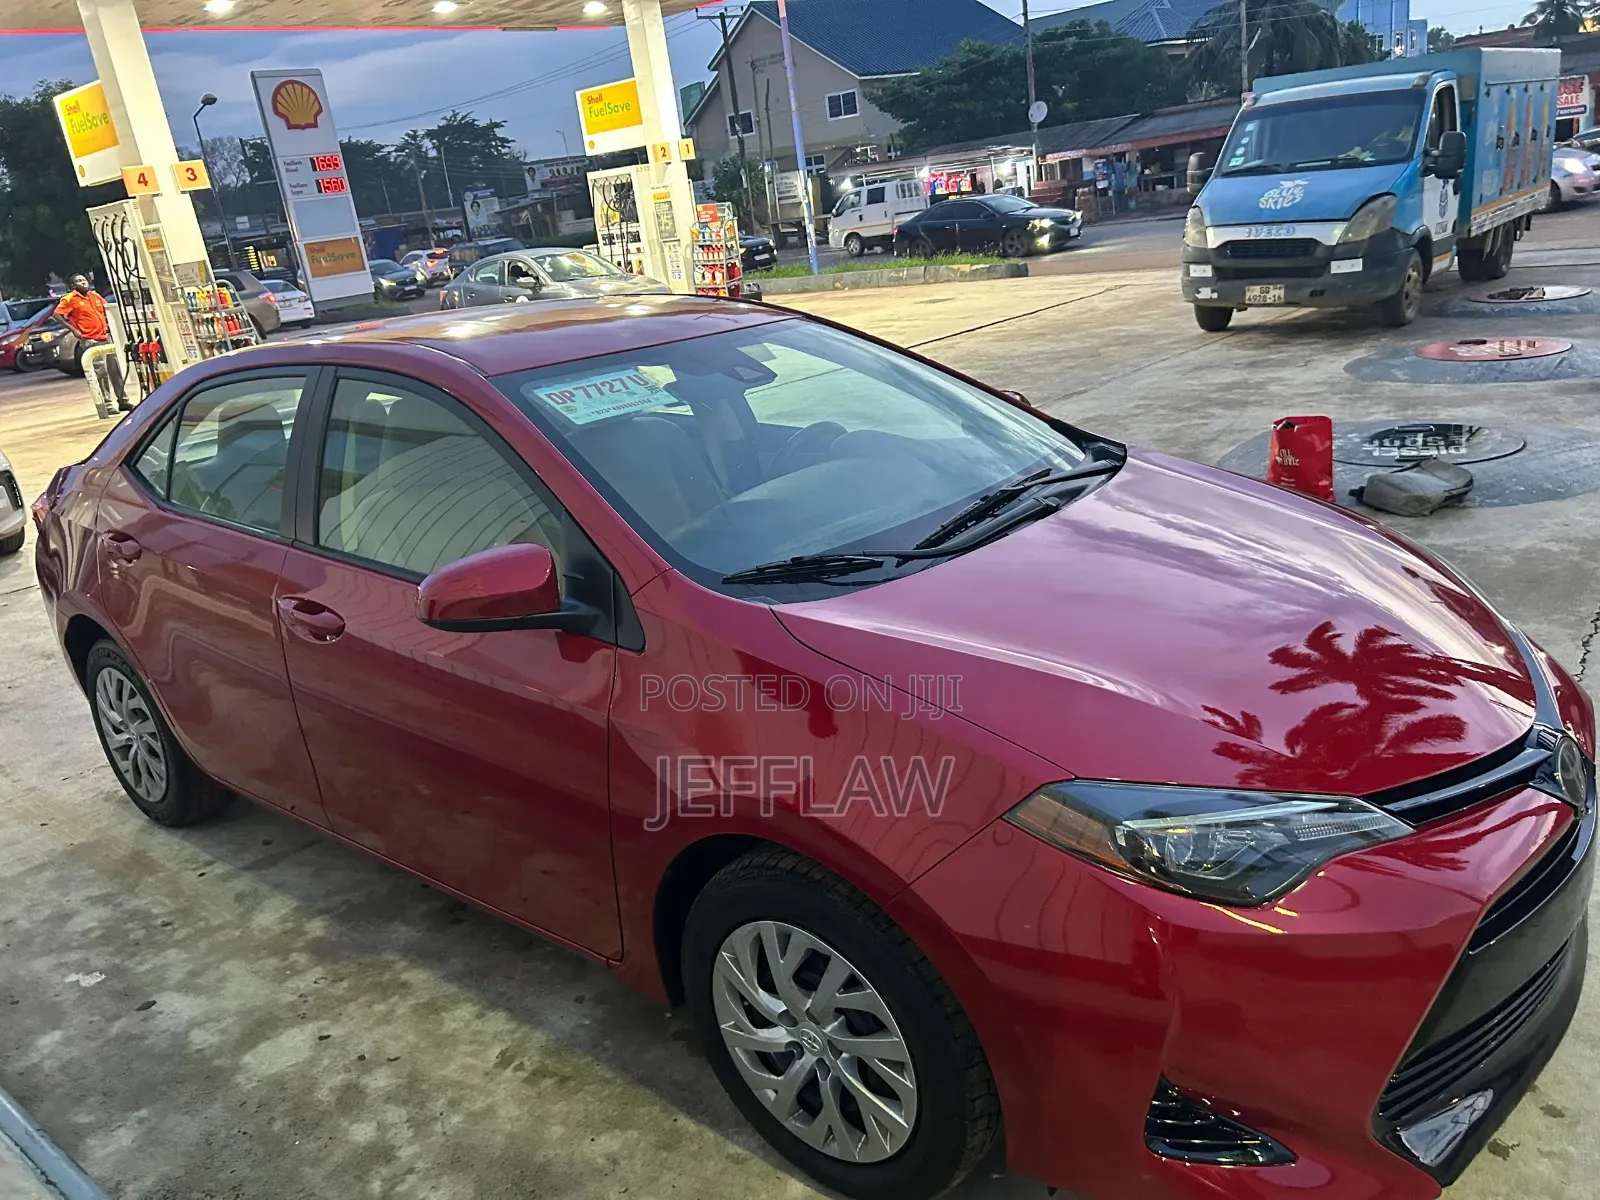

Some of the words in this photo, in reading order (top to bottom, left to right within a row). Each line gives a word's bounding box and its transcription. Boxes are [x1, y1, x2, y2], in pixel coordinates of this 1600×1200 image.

[587, 92, 603, 105] Shell
[1557, 94, 1580, 106] SALE
[65, 99, 81, 116] Shell
[588, 101, 631, 118] FuelSave
[69, 111, 110, 135] FuelSave
[660, 146, 667, 158] 2
[685, 143, 691, 155] 1
[137, 172, 149, 187] 4
[185, 167, 198, 182] 3
[1245, 225, 1295, 238] IVECO
[311, 252, 356, 264] FuelSave
[544, 391, 576, 406] DP
[573, 377, 631, 400] 7727
[625, 373, 650, 387] U
